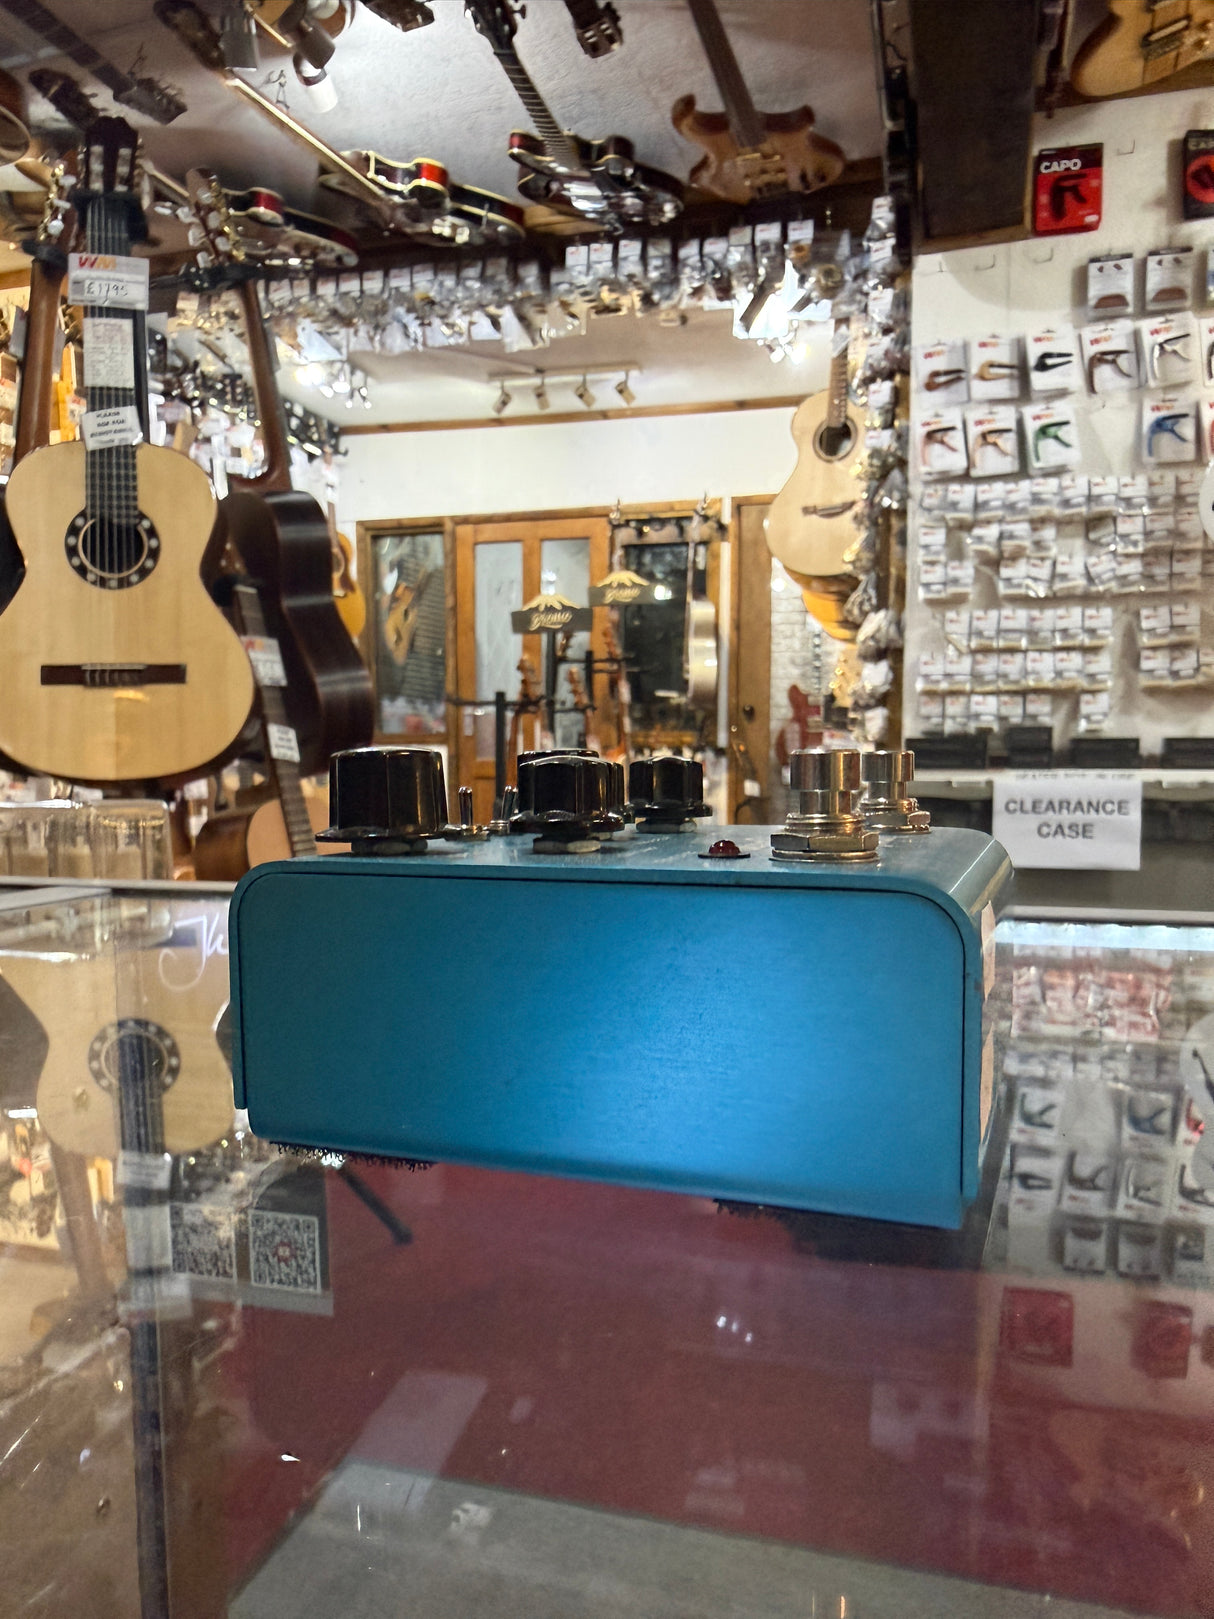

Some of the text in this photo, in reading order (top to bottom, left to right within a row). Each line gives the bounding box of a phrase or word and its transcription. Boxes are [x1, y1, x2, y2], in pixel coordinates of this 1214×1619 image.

[1040, 158, 1082, 174] CAPO
[1004, 797, 1130, 816] CLEARANCE
[1037, 822, 1095, 840] CASE
